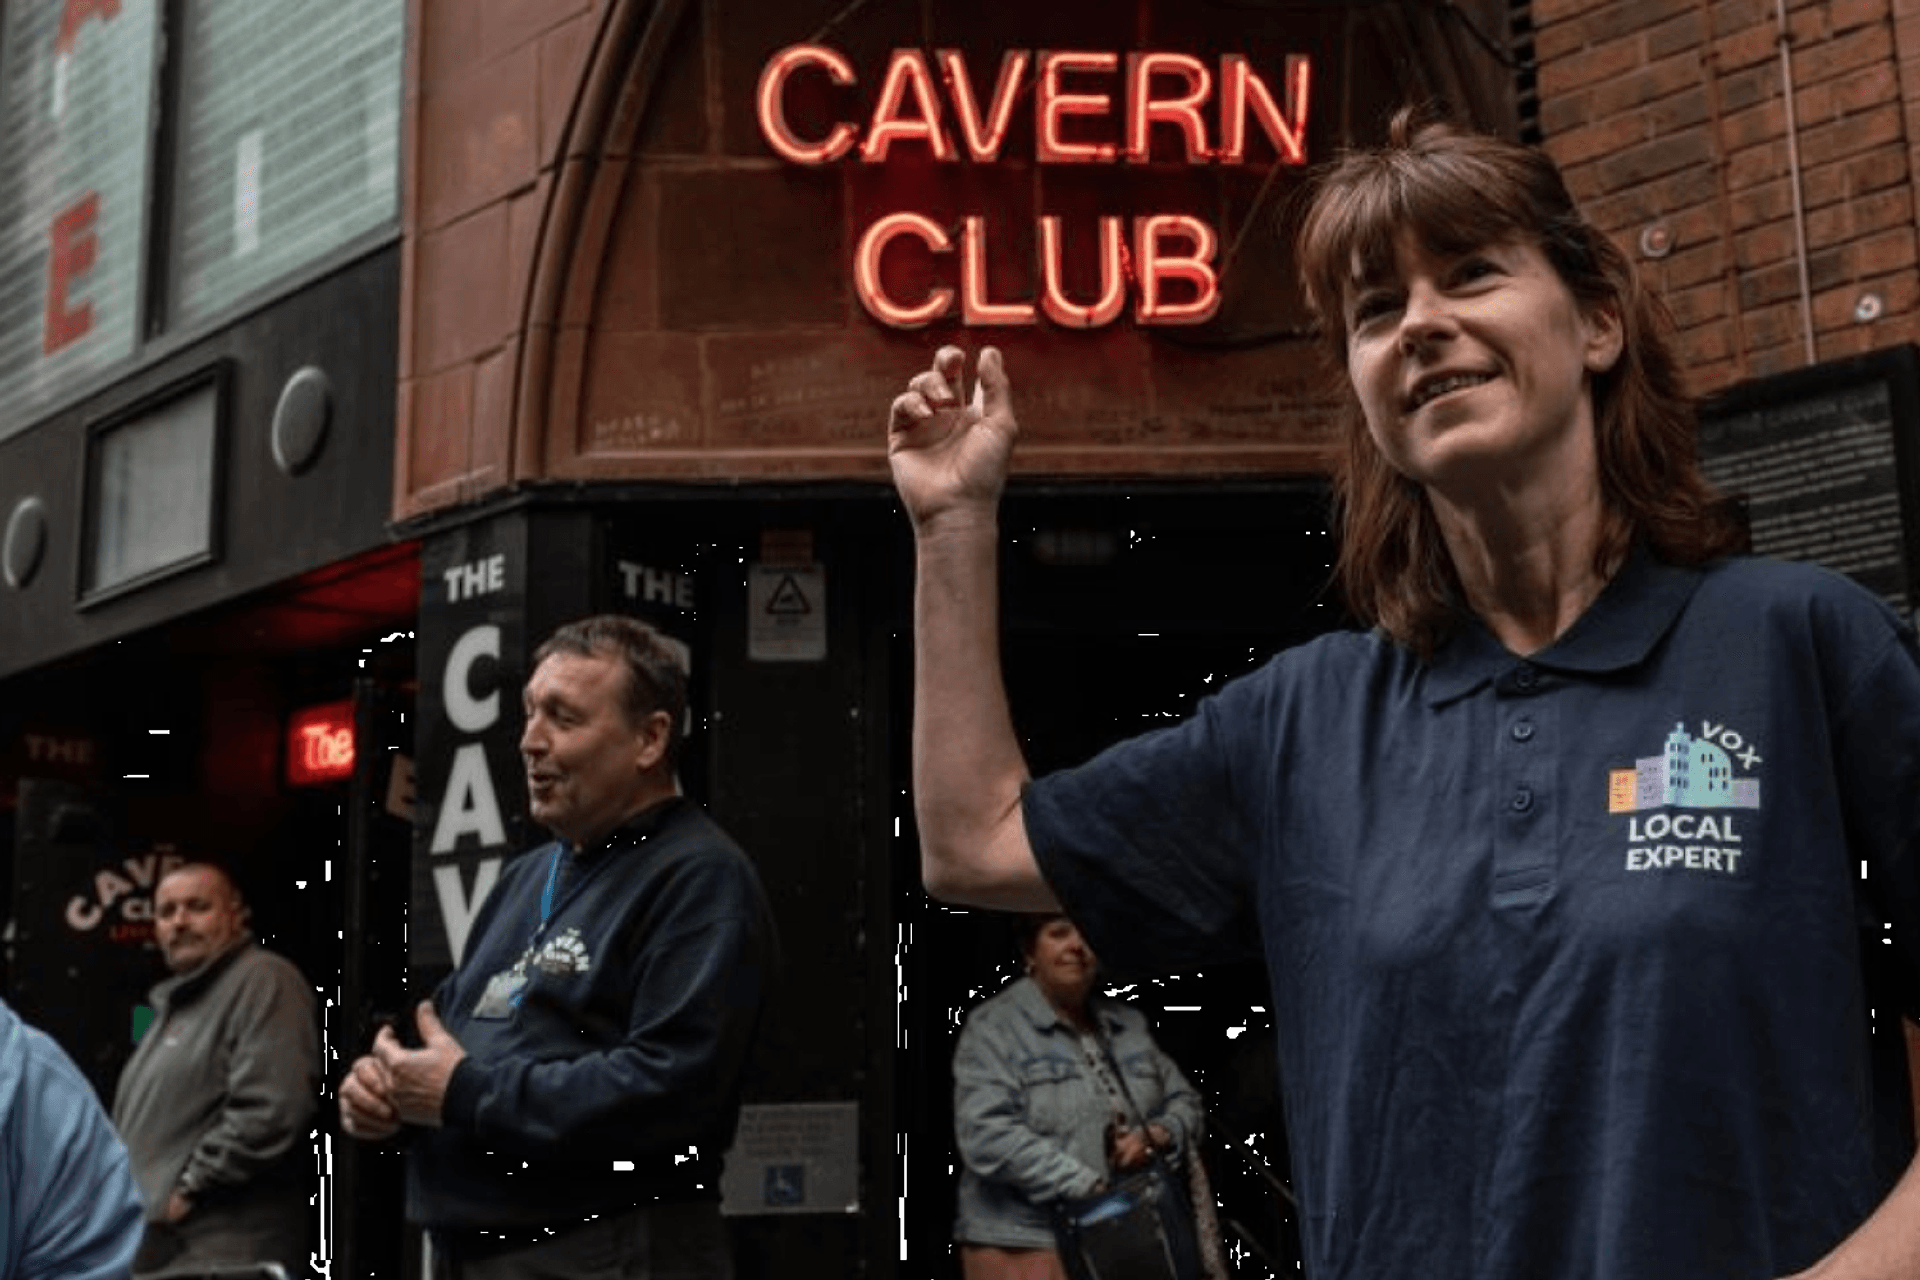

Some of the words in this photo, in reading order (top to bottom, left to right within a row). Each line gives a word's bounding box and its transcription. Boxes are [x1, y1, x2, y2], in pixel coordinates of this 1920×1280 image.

[757, 43, 1311, 166] CAVERN
[854, 213, 1220, 328] CLUB
[444, 555, 505, 603] THE
[619, 562, 694, 608] THE
[301, 722, 355, 770] The
[1702, 720, 1763, 771] VOX
[1628, 814, 1742, 843] LOCAL
[1625, 845, 1742, 873] EXPERT
